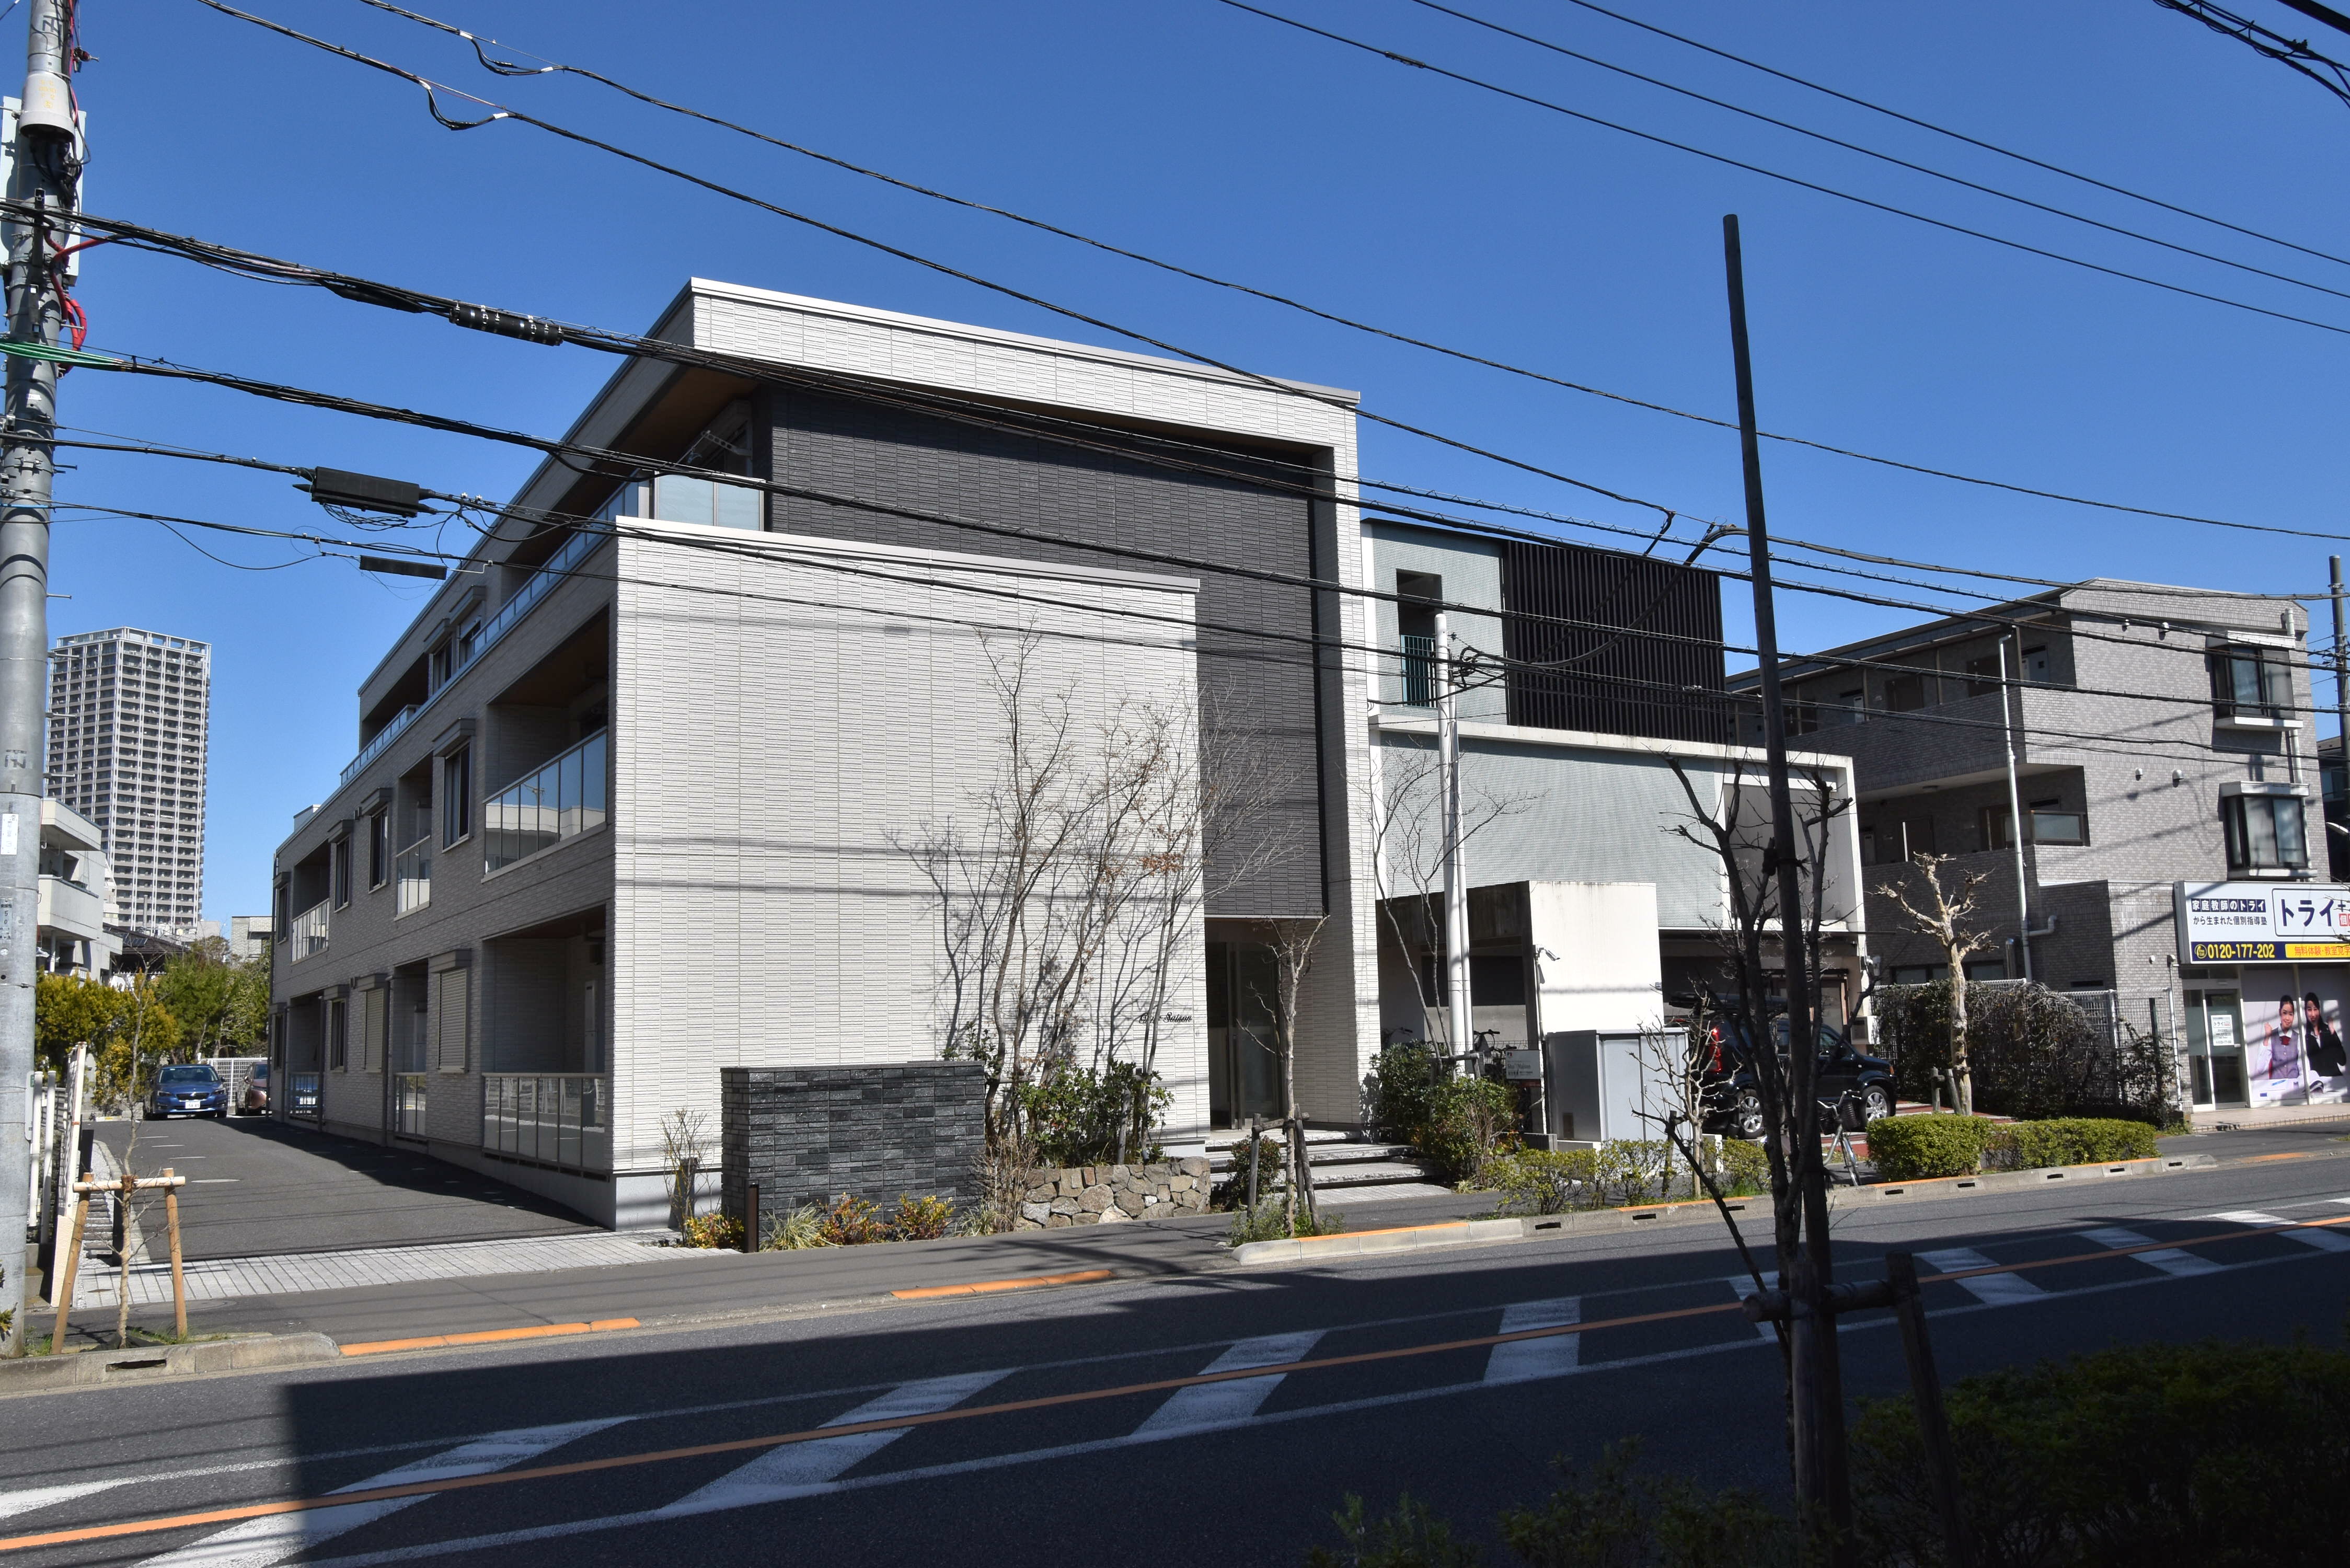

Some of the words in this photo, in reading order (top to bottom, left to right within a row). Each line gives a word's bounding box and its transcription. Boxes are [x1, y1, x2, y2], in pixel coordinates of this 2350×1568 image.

[2192, 900, 2264, 911] 家庭教師のトライ
[2281, 899, 2334, 927] トライ
[2193, 916, 2267, 925] から生まれた個別指導塾
[2208, 944, 2275, 959] 0120-177-202
